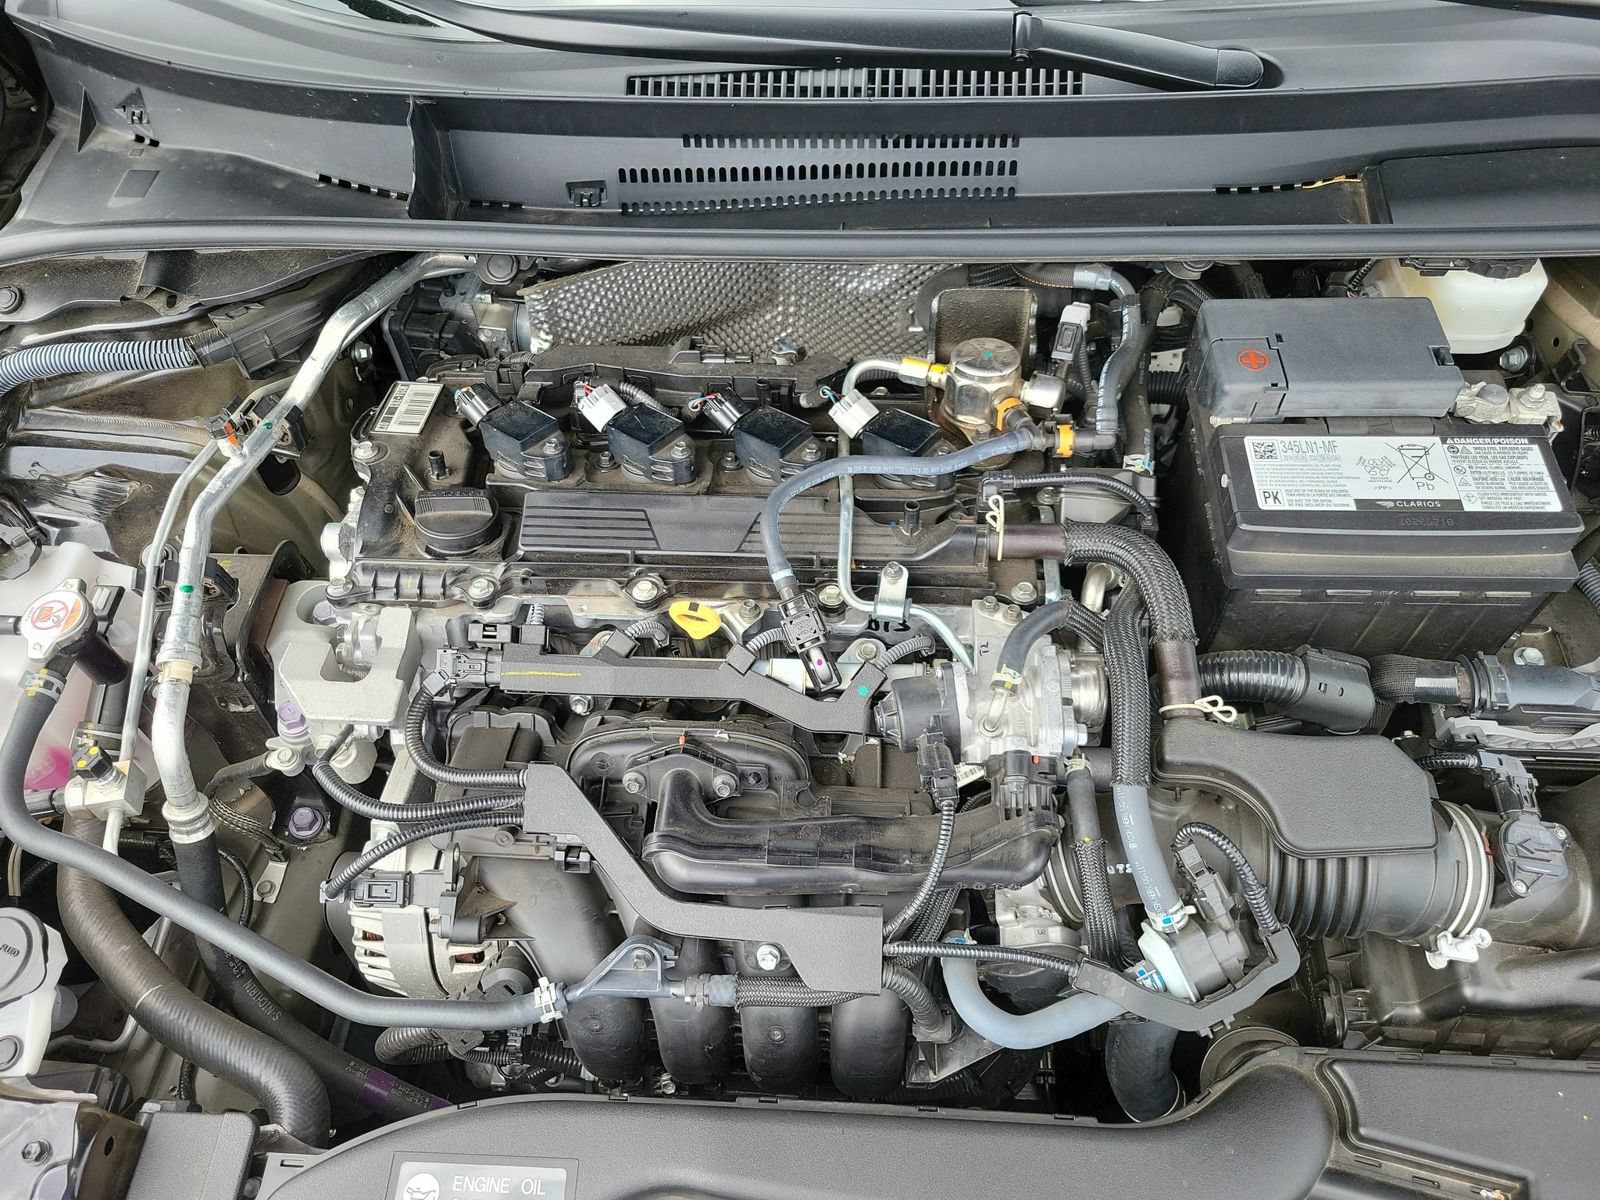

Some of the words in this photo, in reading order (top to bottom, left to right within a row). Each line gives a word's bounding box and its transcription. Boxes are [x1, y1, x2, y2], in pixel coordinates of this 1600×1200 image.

[1280, 440, 1339, 454] 345LN1-MF
[1453, 437, 1529, 445] DANGER/POISON
[1415, 481, 1435, 491] Pb
[1262, 490, 1282, 505] PK
[1395, 500, 1441, 508] CLARIOS
[451, 1175, 511, 1194] ENGINE
[520, 1178, 546, 1196] OIL
